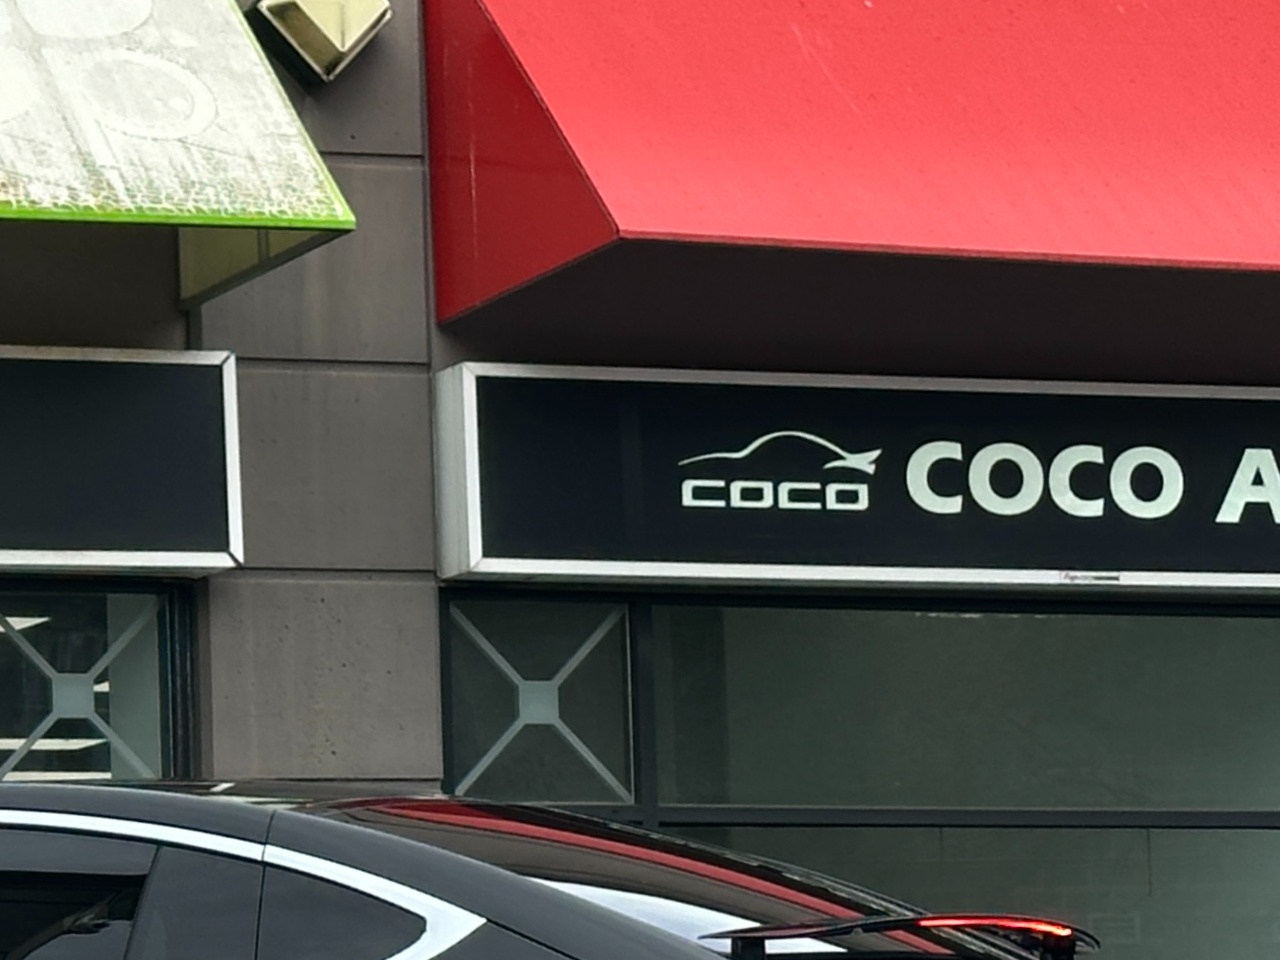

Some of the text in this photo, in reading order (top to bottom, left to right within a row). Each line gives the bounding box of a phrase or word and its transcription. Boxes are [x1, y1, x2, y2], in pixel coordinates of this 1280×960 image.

[682, 479, 869, 511] COCO
[907, 441, 1280, 524] COCO A
